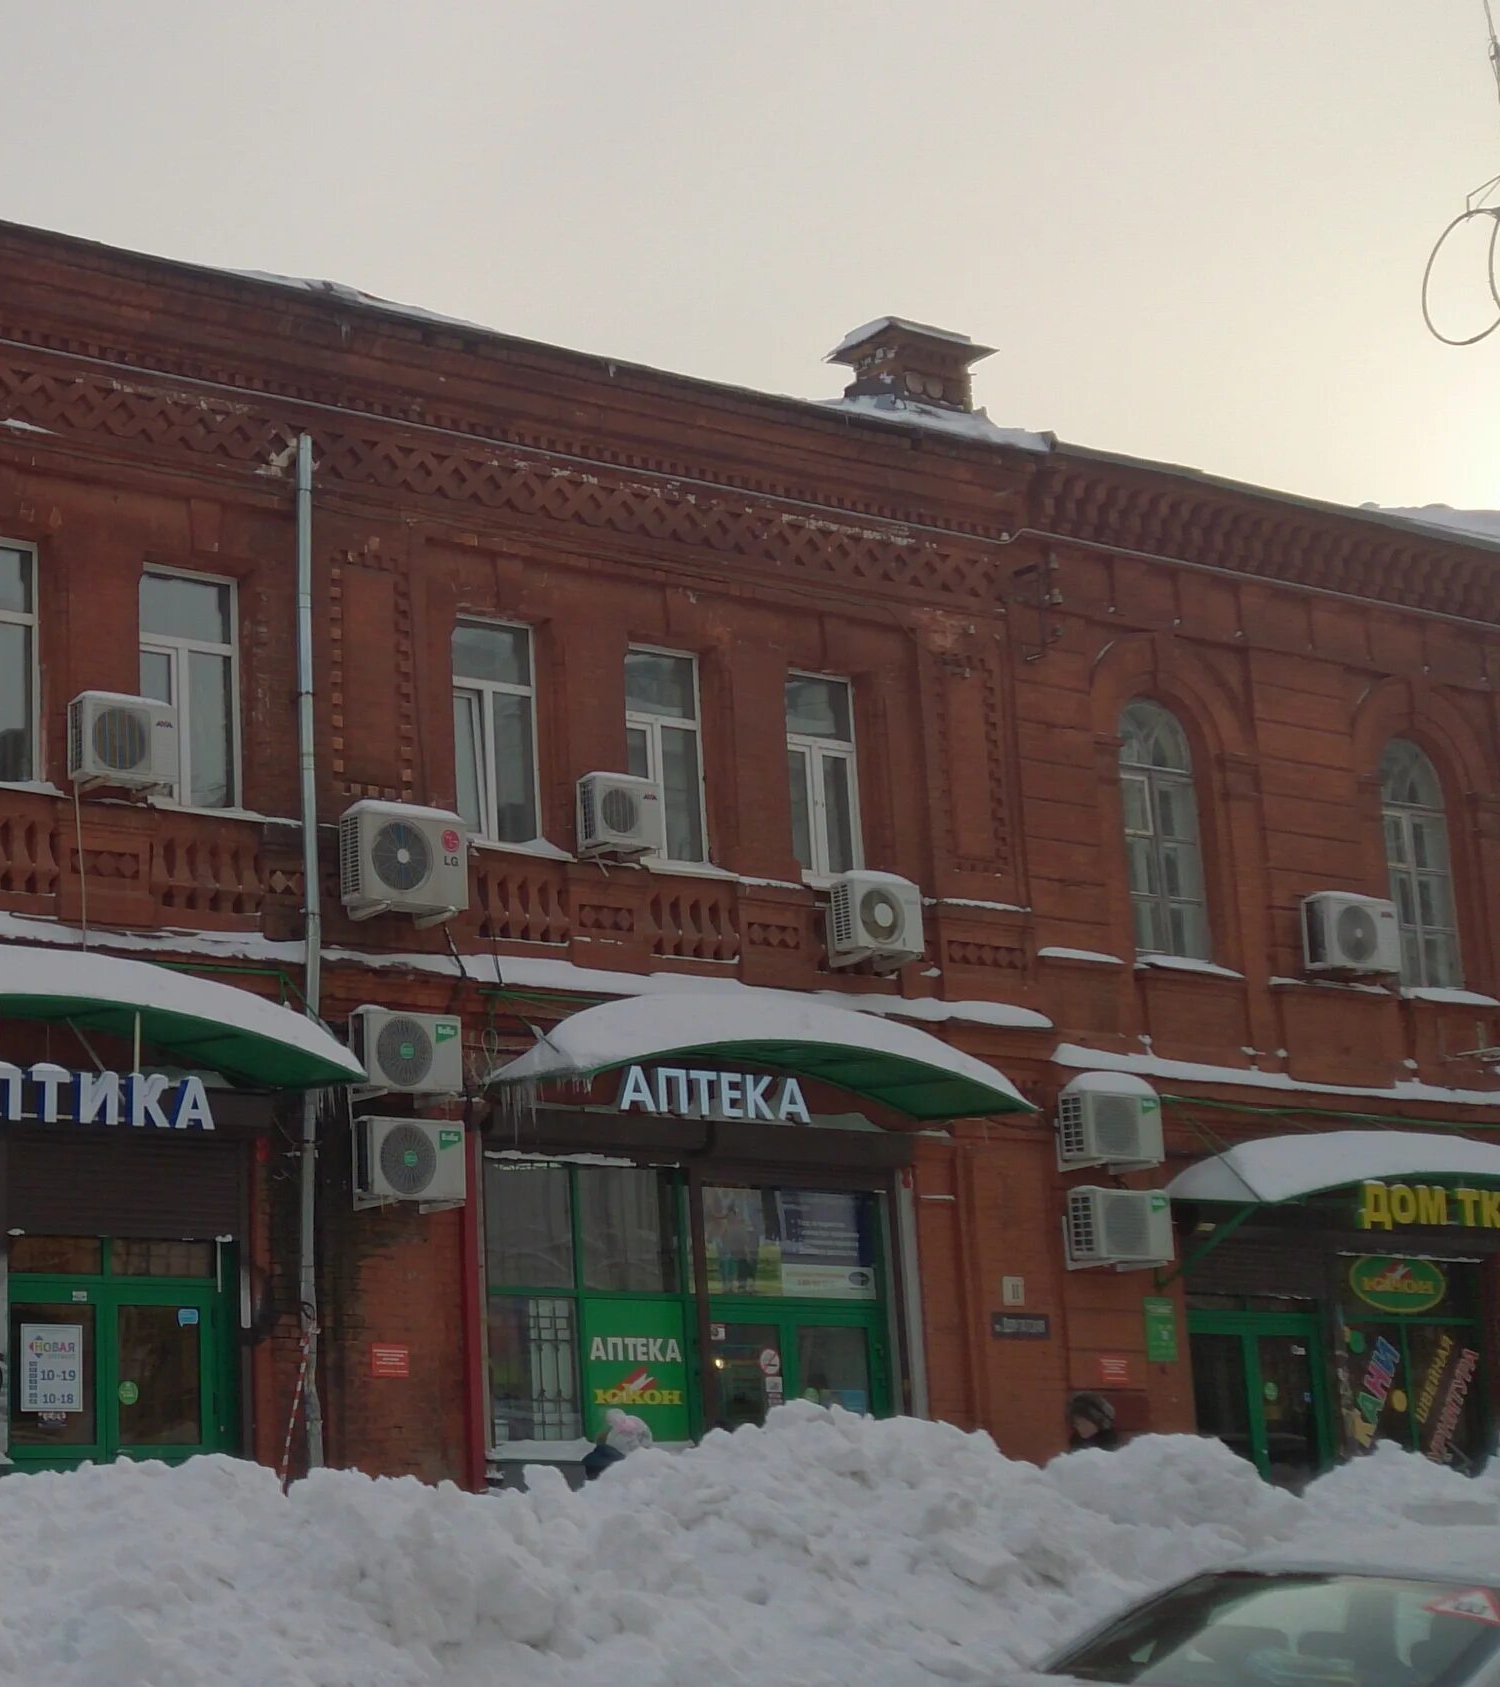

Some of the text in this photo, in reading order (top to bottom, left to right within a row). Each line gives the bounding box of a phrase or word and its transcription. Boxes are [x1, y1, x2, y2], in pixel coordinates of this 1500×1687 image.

[443, 856, 459, 867] LG
[619, 1064, 811, 1124] АПТЕКА
[1358, 1180, 1447, 1230] ДОМ
[35, 1342, 75, 1353] НОВАЯ
[590, 1337, 682, 1362] АПТЕКА
